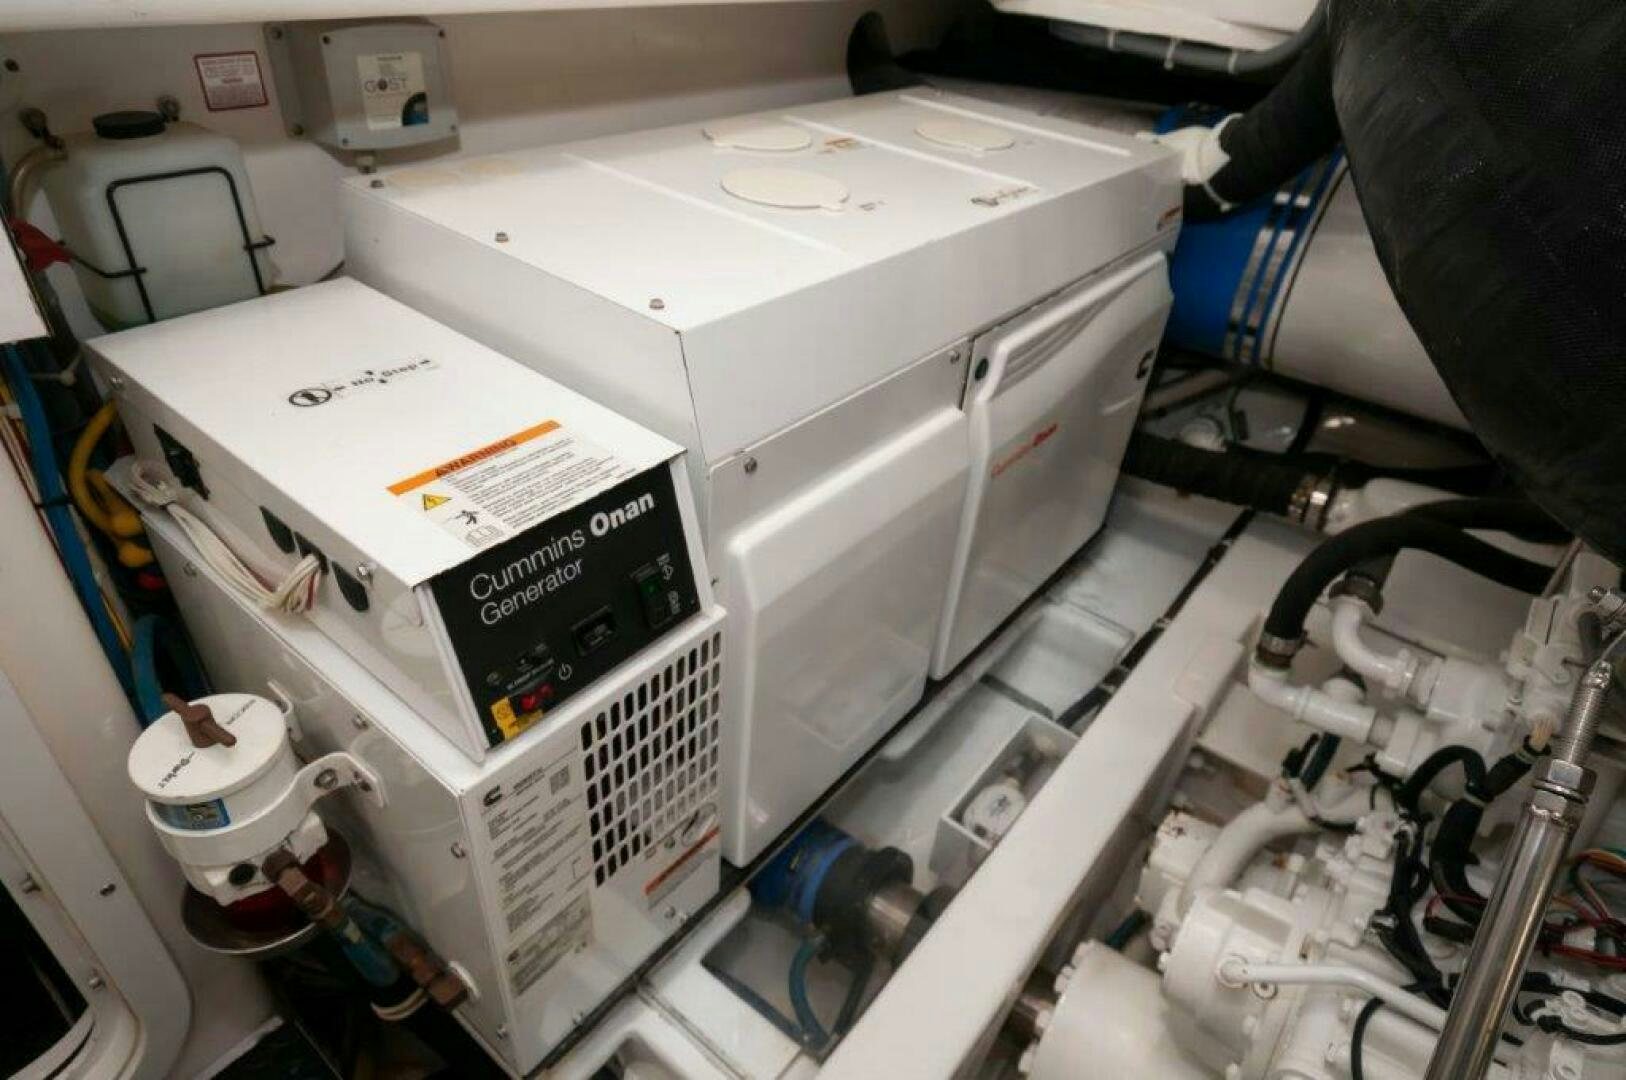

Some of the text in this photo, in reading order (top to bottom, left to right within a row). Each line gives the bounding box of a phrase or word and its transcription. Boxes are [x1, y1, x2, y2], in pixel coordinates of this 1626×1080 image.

[446, 438, 517, 473] WARNING
[470, 492, 656, 600] Cummins Onan
[480, 558, 583, 625] Generator
